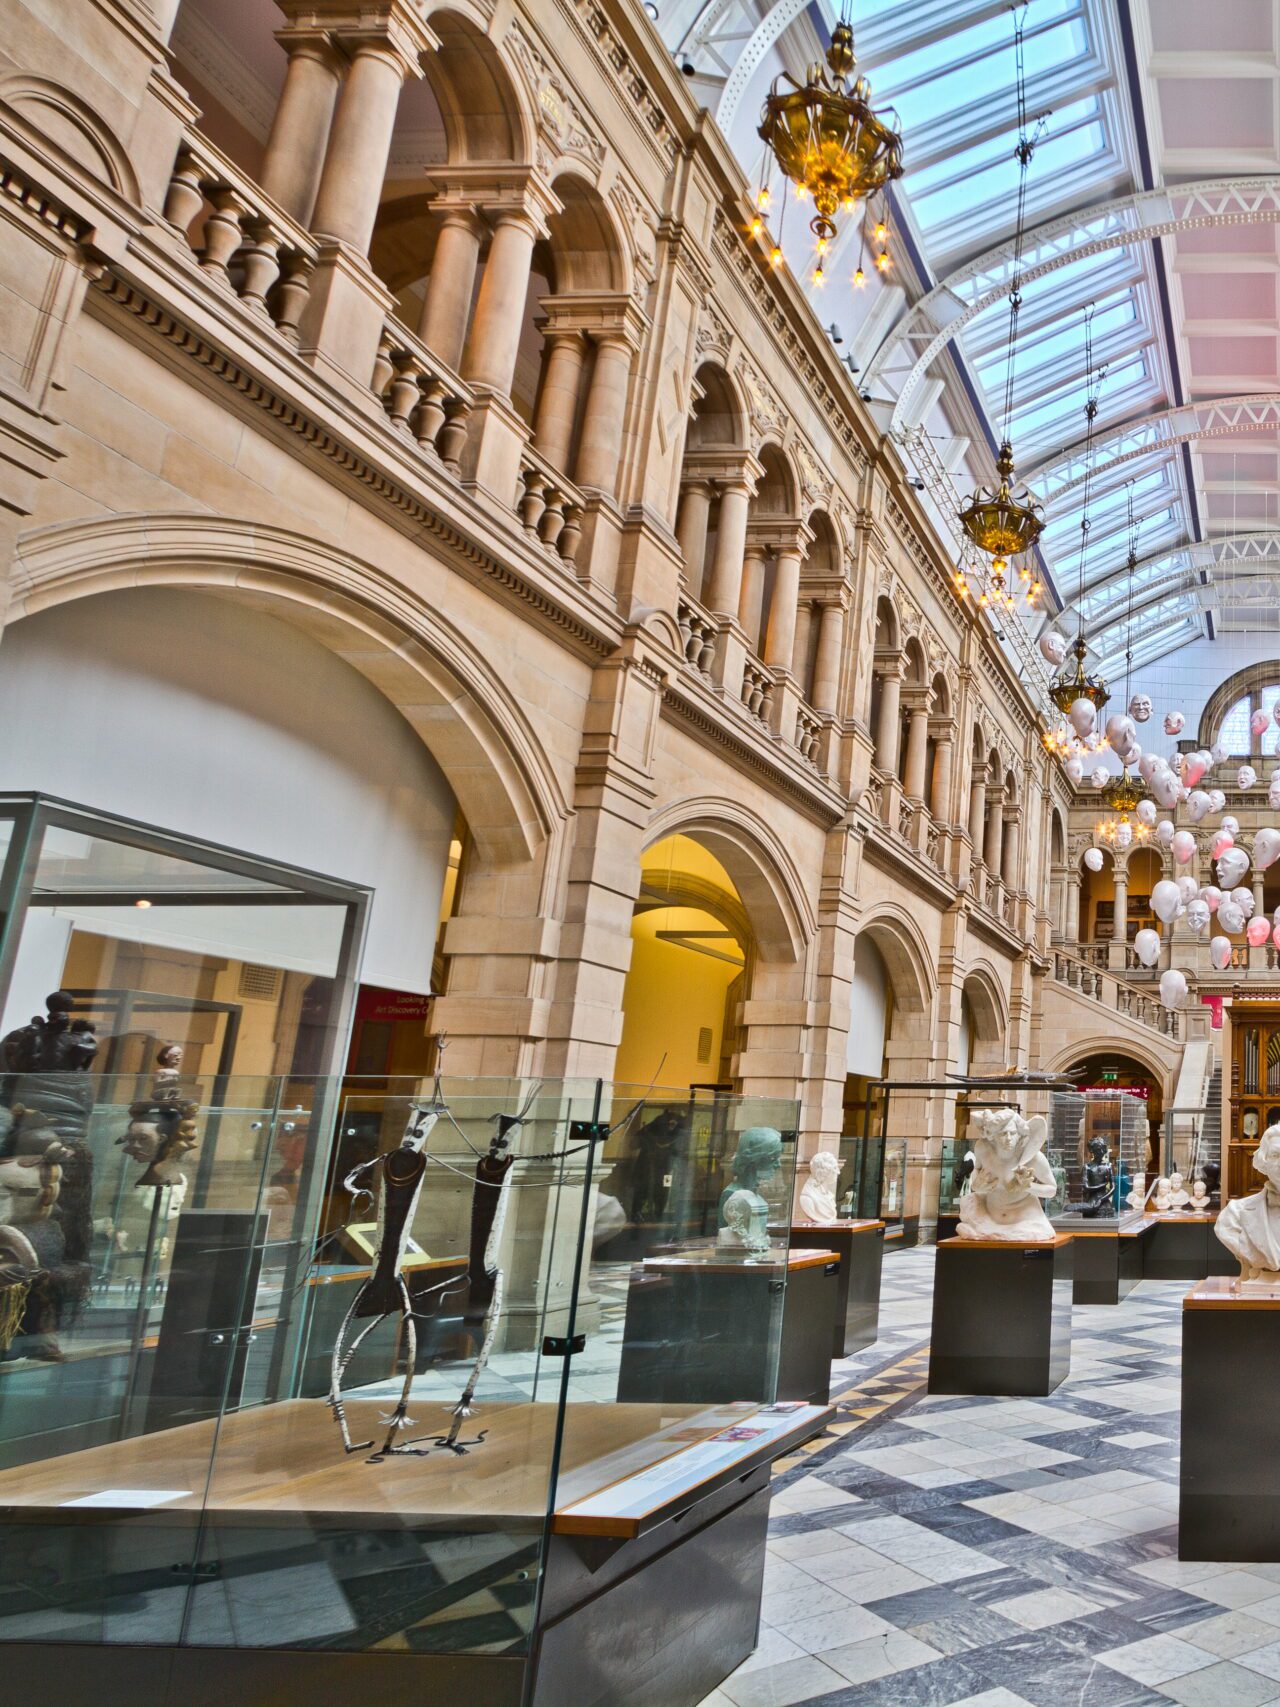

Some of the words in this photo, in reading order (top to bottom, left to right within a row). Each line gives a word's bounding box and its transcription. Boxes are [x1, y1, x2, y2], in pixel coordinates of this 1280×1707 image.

[397, 995, 424, 1005] Looking
[376, 1006, 387, 1014] Art
[388, 1006, 421, 1016] Discovery
